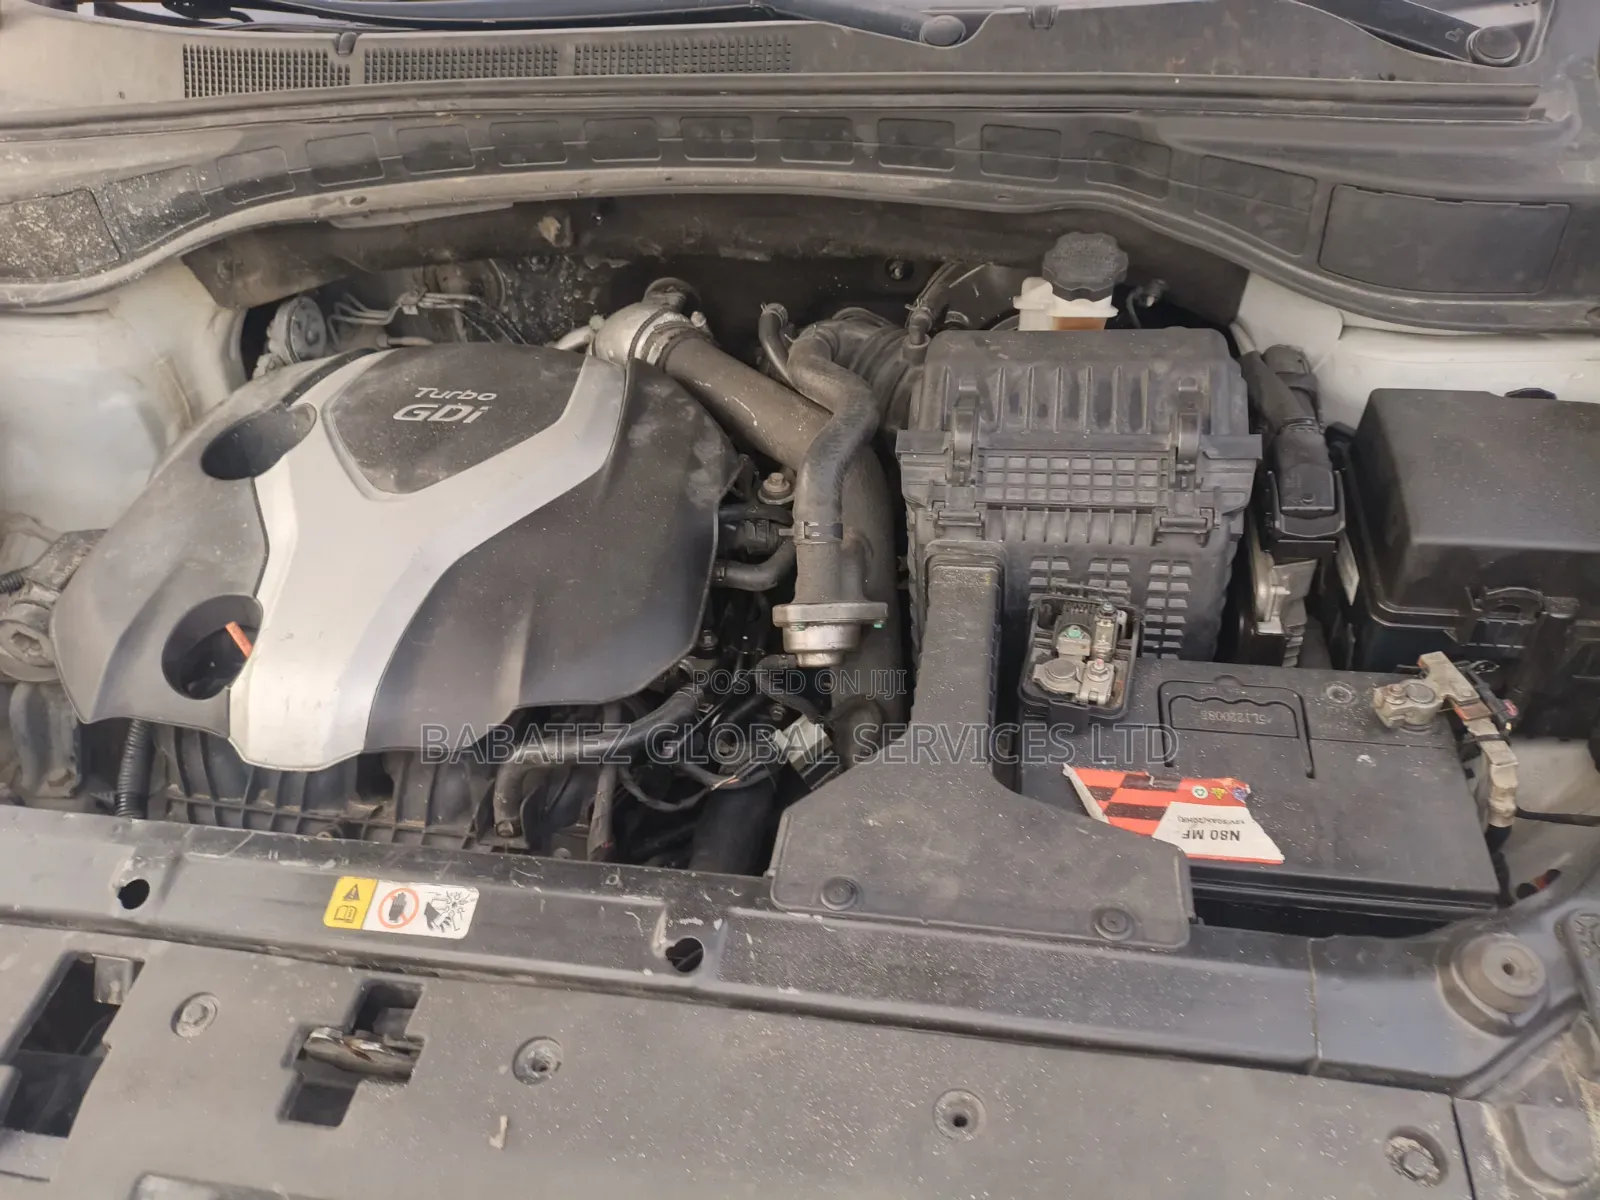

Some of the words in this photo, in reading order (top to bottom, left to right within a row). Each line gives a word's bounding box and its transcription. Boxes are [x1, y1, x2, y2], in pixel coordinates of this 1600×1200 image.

[415, 387, 498, 401] Turbo
[393, 403, 490, 424] GDi
[1182, 829, 1205, 841] MF
[1210, 829, 1241, 842] N80
